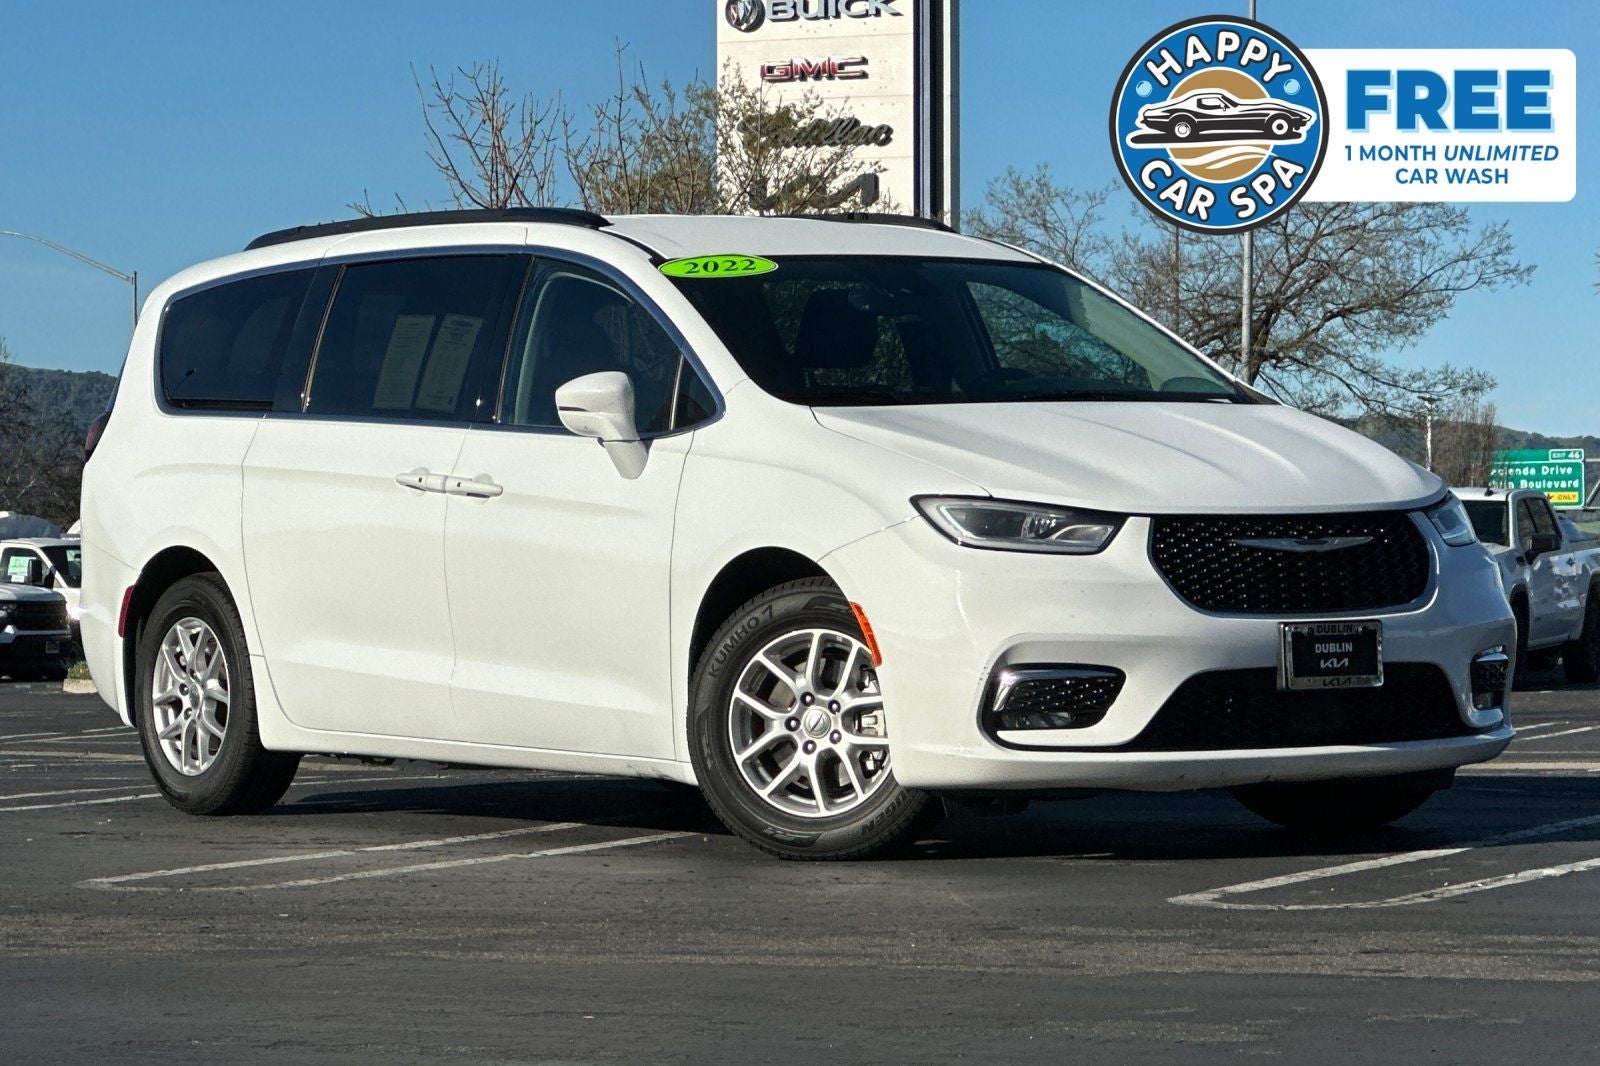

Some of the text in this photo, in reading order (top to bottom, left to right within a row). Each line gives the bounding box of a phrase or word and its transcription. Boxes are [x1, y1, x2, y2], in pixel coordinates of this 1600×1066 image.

[765, 0, 904, 22] BUICK
[760, 55, 868, 81] GMC
[684, 259, 757, 274] 2022
[1567, 451, 1580, 459] 46
[1541, 465, 1573, 475] Drive
[1520, 479, 1580, 489] Boulevard
[1316, 624, 1354, 634] DUBLIN
[707, 615, 762, 679] KUMHO
[1315, 642, 1353, 654] DUBLIN
